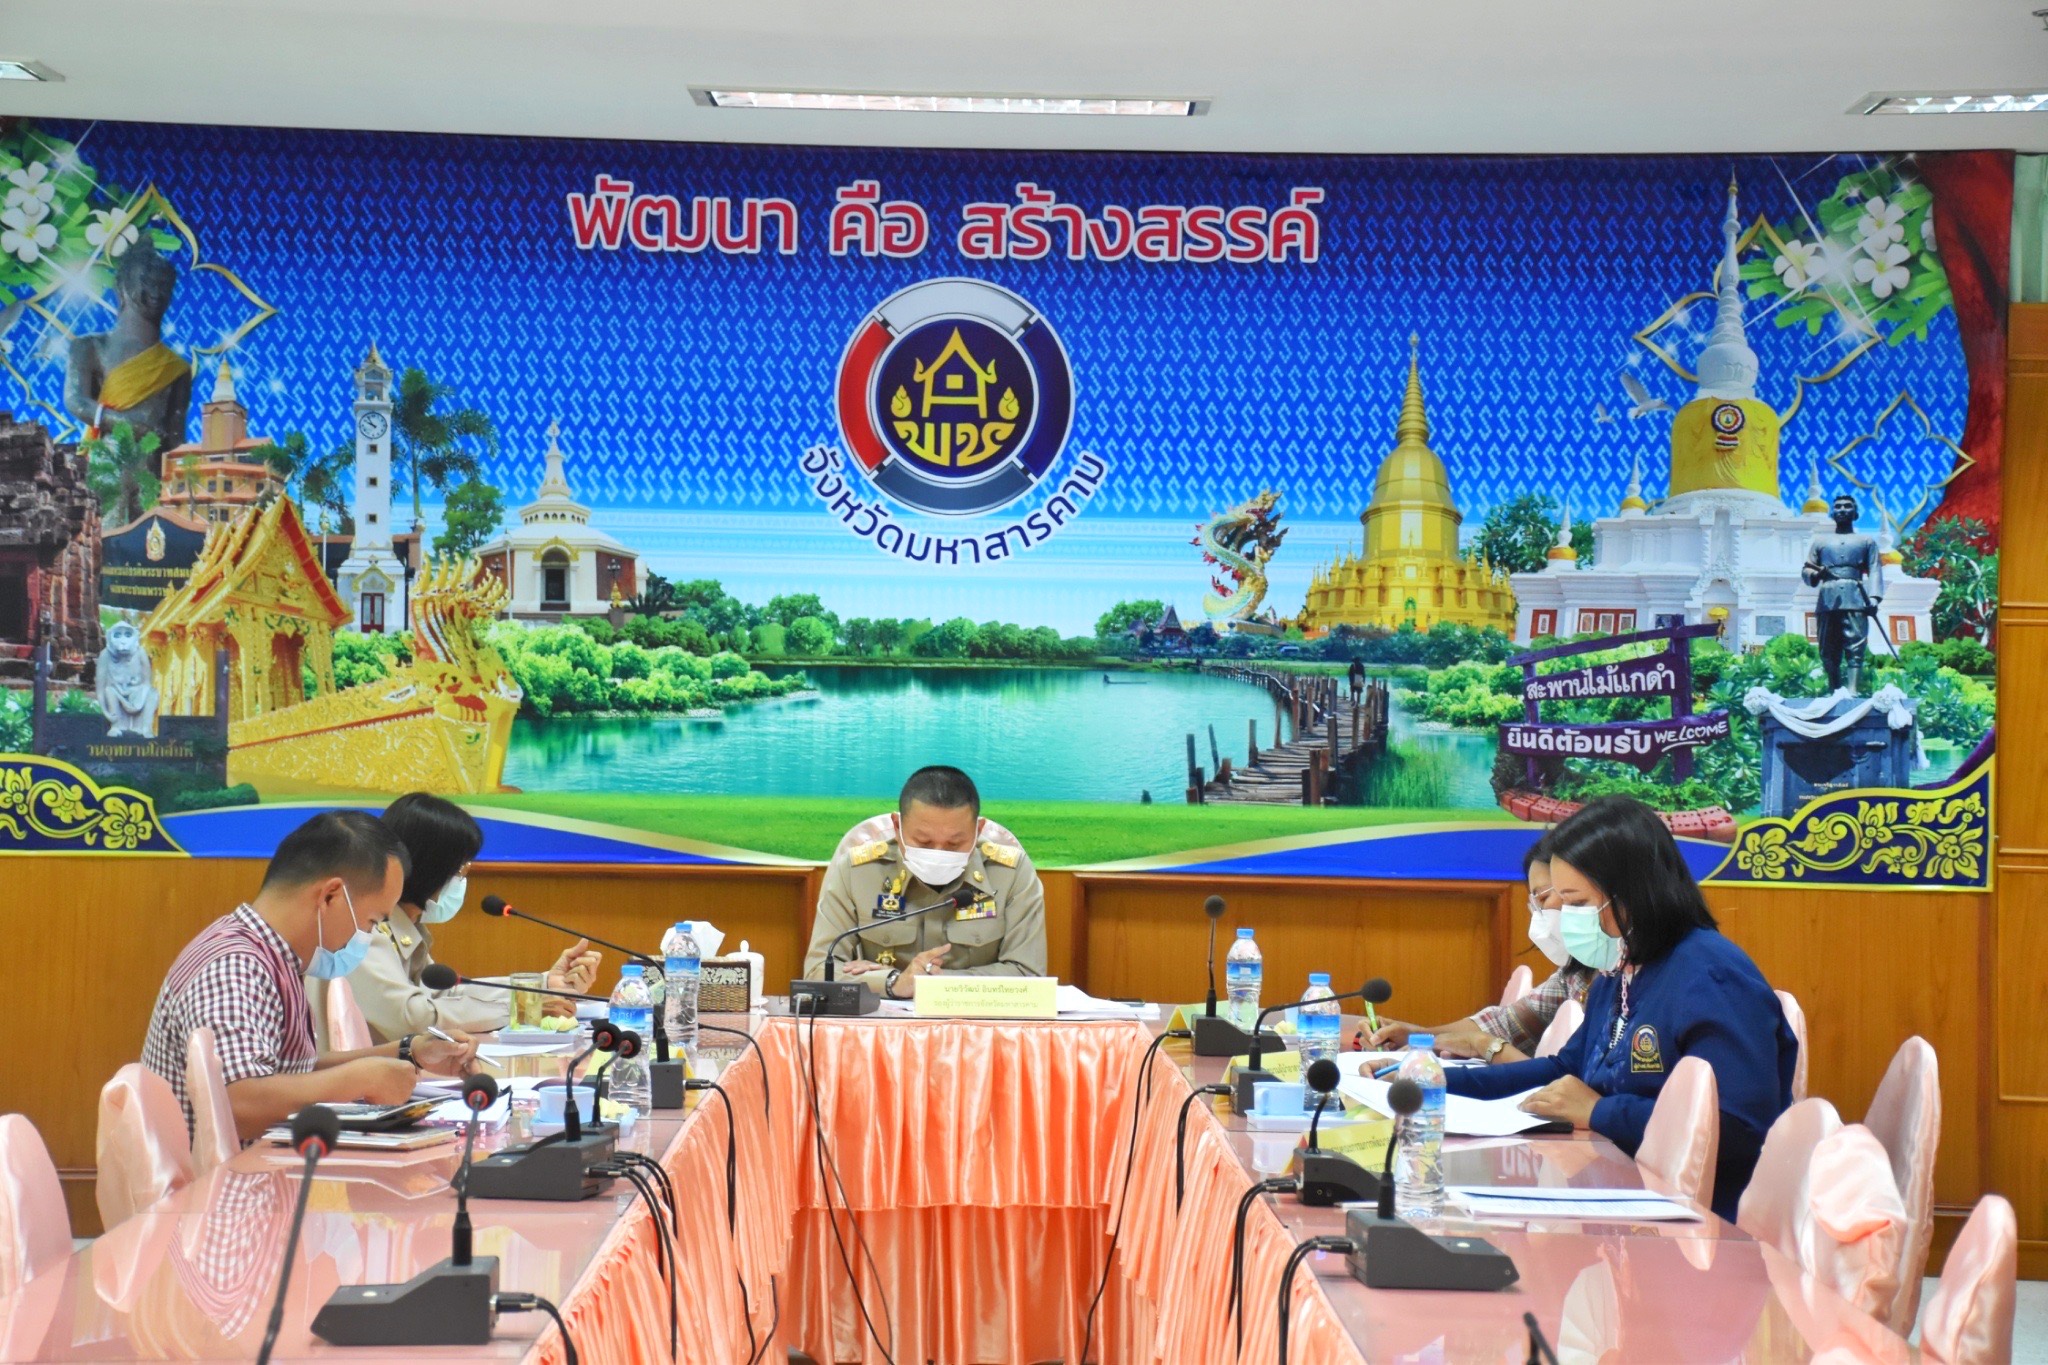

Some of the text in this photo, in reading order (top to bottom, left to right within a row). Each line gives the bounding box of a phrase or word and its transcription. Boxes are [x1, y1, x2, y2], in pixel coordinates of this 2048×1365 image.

[568, 174, 1324, 263] พัฒนา คือ สร้างสรรค์
[802, 446, 1105, 565] จังหวัดมหาสารคาม
[1526, 663, 1676, 700] สะพานไม้แกดำ
[1507, 727, 1651, 755] ยินดีต้อนรับ
